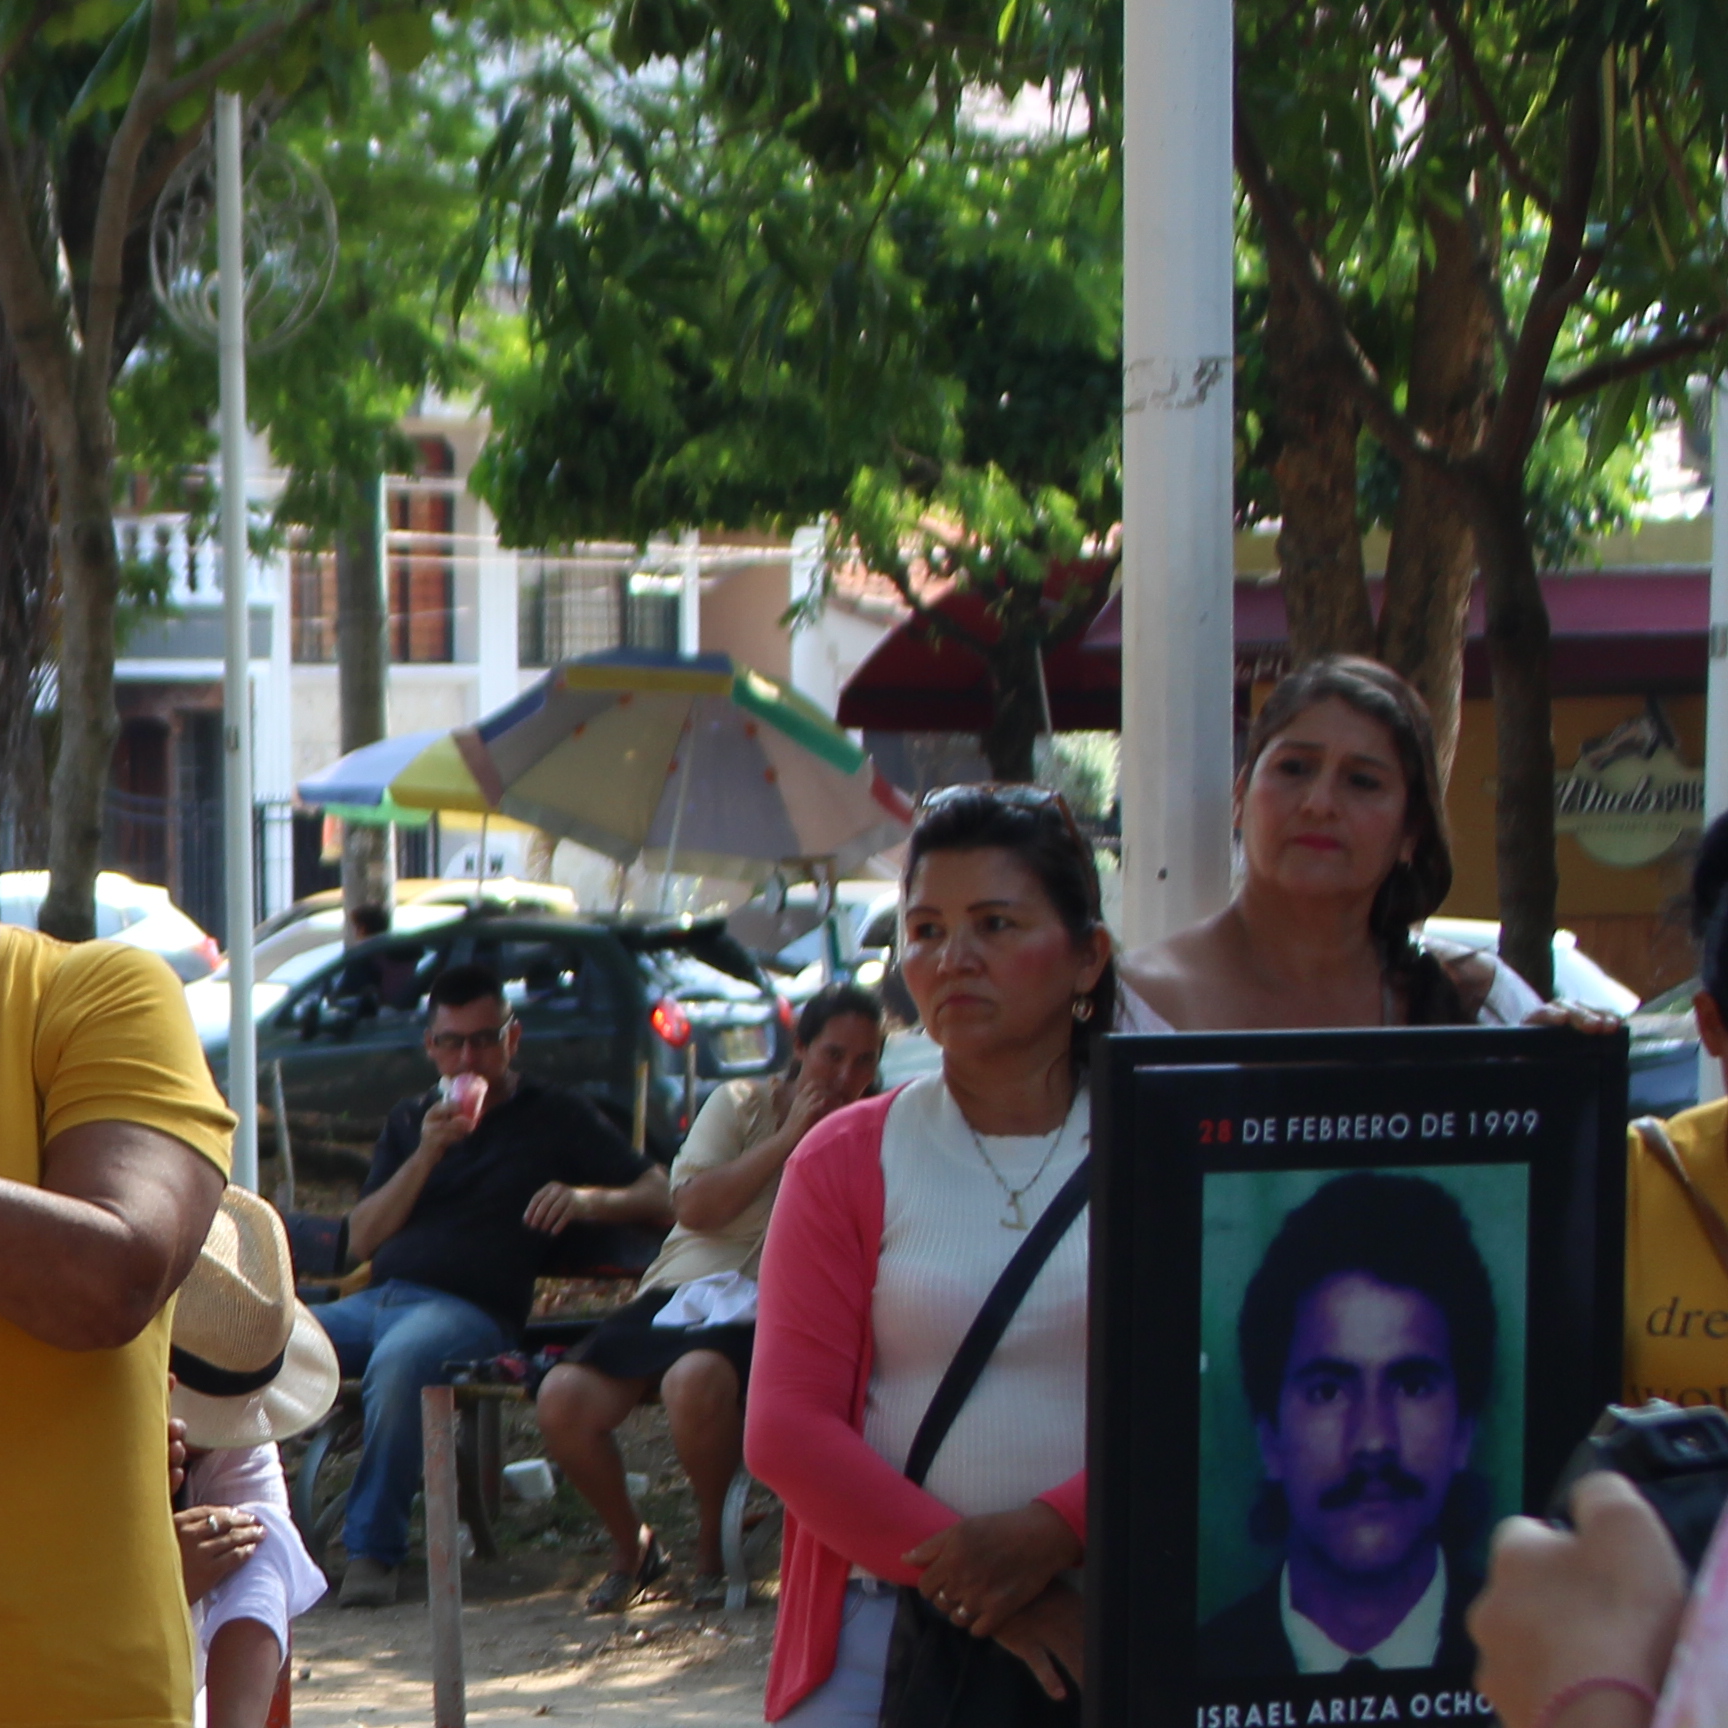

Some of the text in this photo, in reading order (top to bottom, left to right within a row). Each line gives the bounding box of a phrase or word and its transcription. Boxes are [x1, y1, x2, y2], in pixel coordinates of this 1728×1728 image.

[1199, 1109, 1539, 1144] 28 DE FEBRERO DE 1999
[1307, 1695, 1400, 1725] ARIZA
